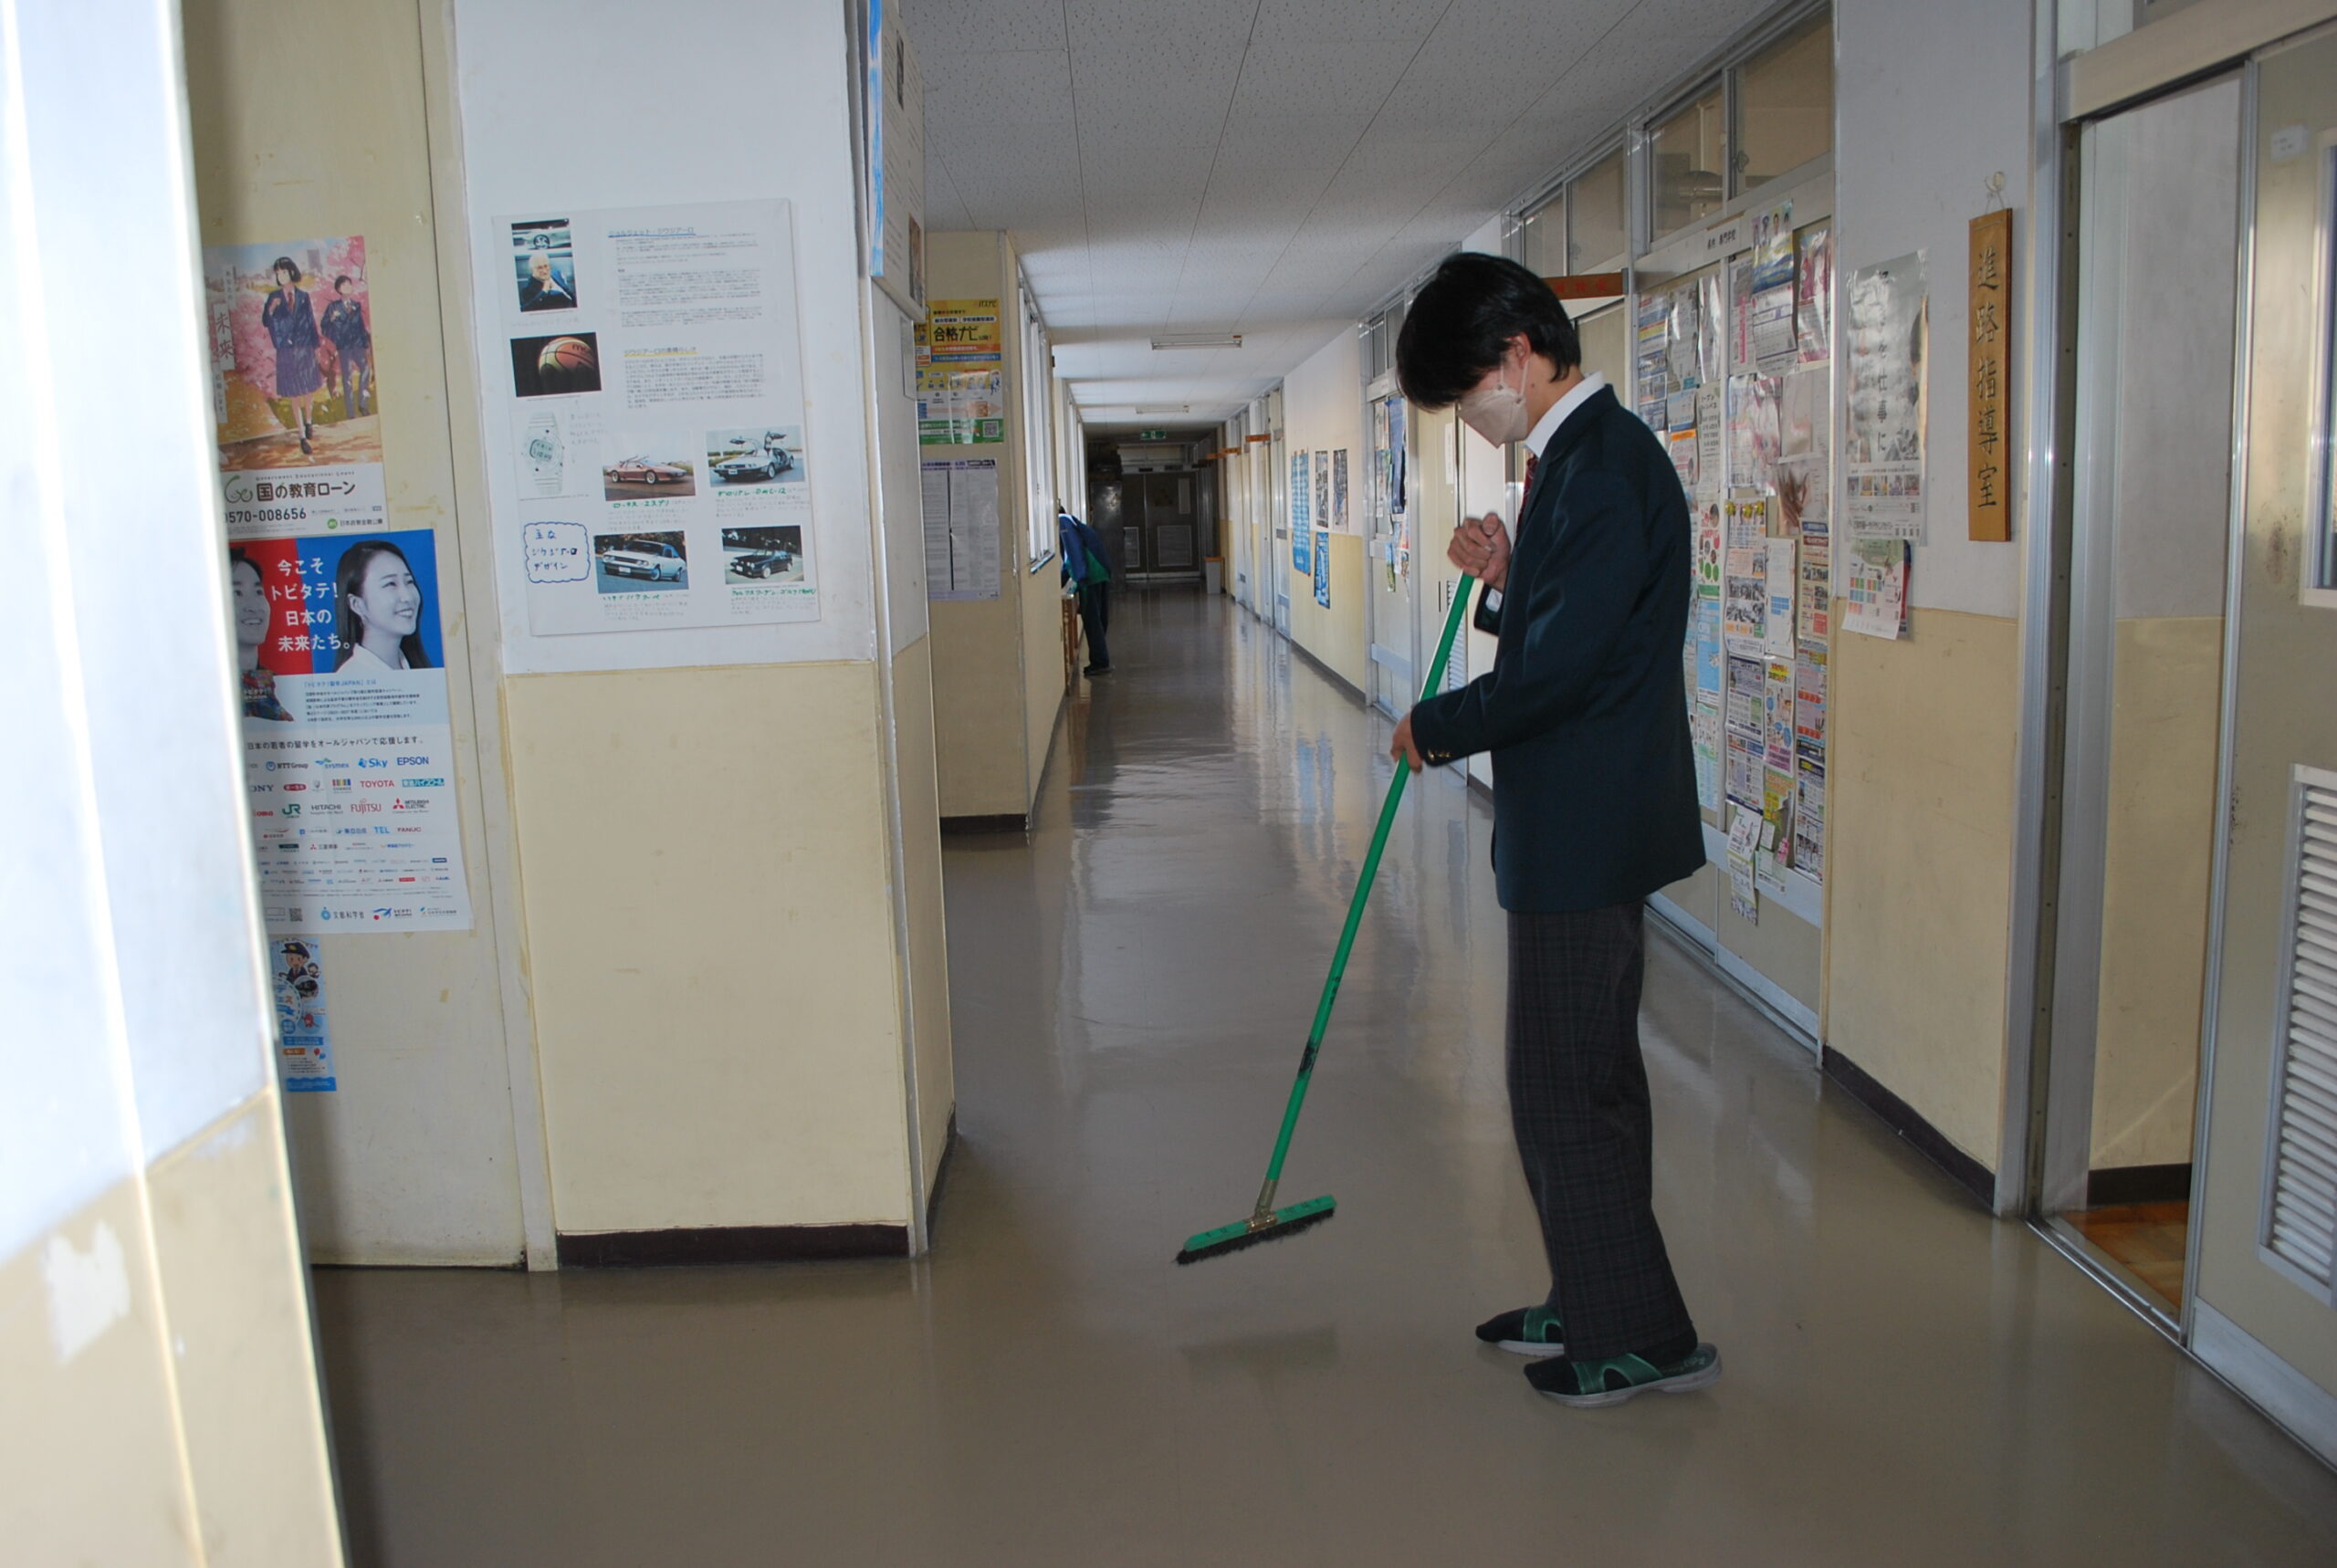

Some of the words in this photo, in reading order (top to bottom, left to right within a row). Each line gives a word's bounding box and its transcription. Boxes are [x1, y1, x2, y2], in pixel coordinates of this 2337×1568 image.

[1975, 245, 1999, 508] 進路指導室
[257, 481, 356, 502] 国の教育ローン
[278, 558, 324, 576] 今こそ
[534, 562, 568, 571] デザイン
[271, 582, 339, 601] トビタテ!
[286, 610, 332, 626] 日本の
[278, 633, 351, 653] 未来たち。
[369, 758, 388, 768] Sky
[397, 756, 429, 766] EPSON
[360, 779, 395, 788] TOYOTA
[282, 804, 301, 815] JR
[351, 803, 382, 814] FUJITSU
[373, 826, 390, 834] TEL
